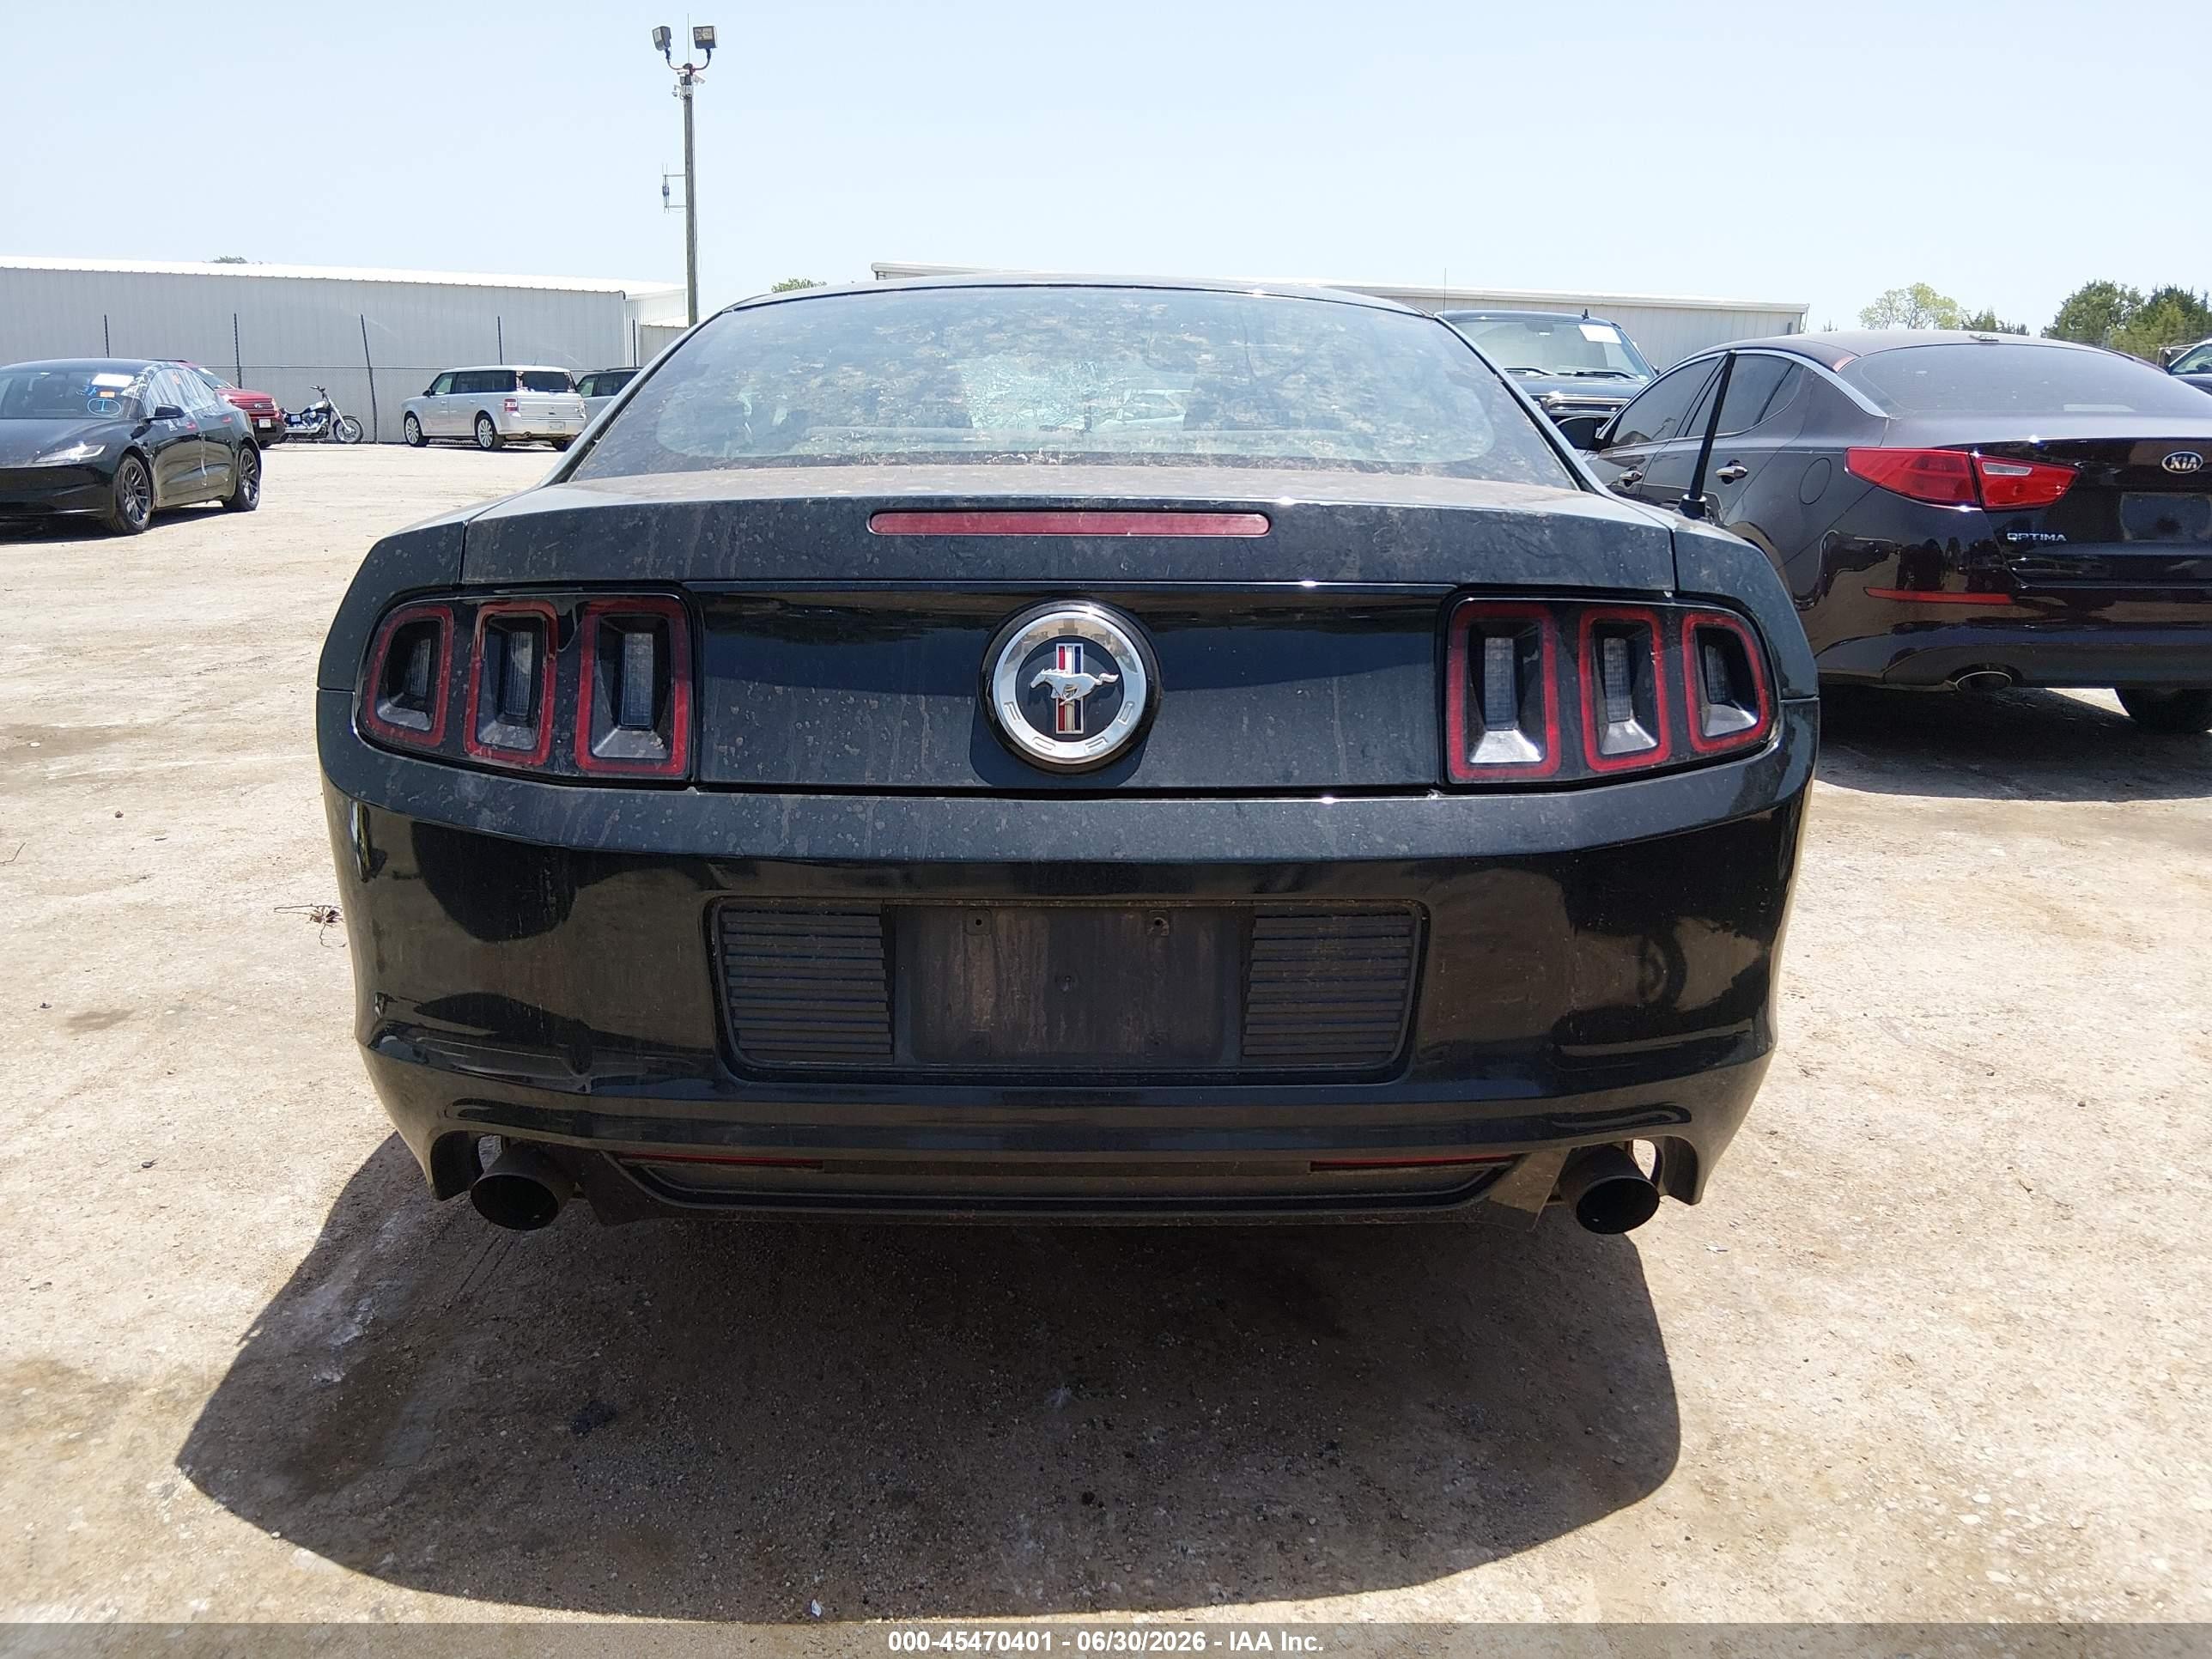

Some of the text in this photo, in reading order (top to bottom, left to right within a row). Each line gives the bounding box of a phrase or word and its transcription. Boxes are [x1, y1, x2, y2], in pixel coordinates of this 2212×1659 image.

[2169, 456, 2197, 470] KIA
[2007, 532, 2067, 542] OPTIMA
[1003, 701, 1135, 754] FORD
